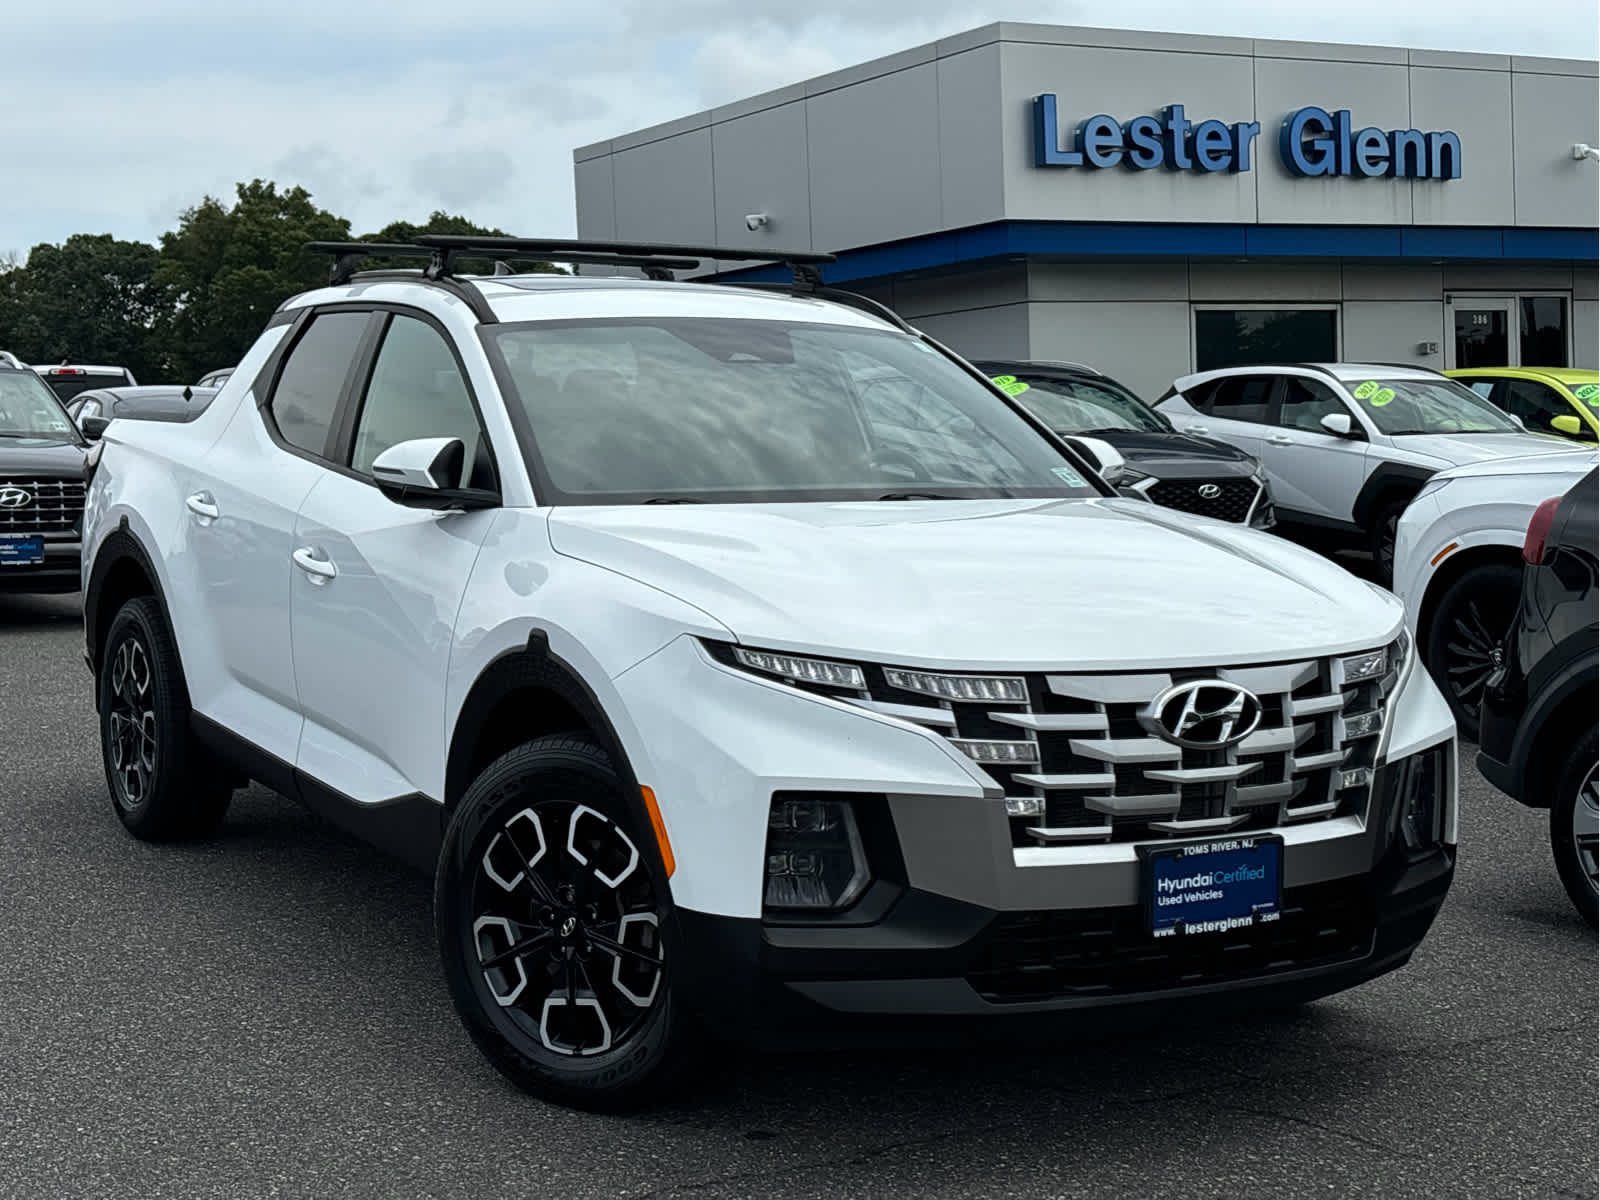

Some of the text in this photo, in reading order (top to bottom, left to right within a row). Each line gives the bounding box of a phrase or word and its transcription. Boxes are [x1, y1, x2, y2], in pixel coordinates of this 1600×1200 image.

[1034, 93, 1462, 181] Lester Glenn
[1472, 314, 1488, 325] 386
[1183, 844, 1209, 856] TOMS
[1157, 864, 1265, 894] Hyundai Certified
[1157, 889, 1224, 906] Used Vehicles
[1185, 915, 1253, 935] lesterglenn
